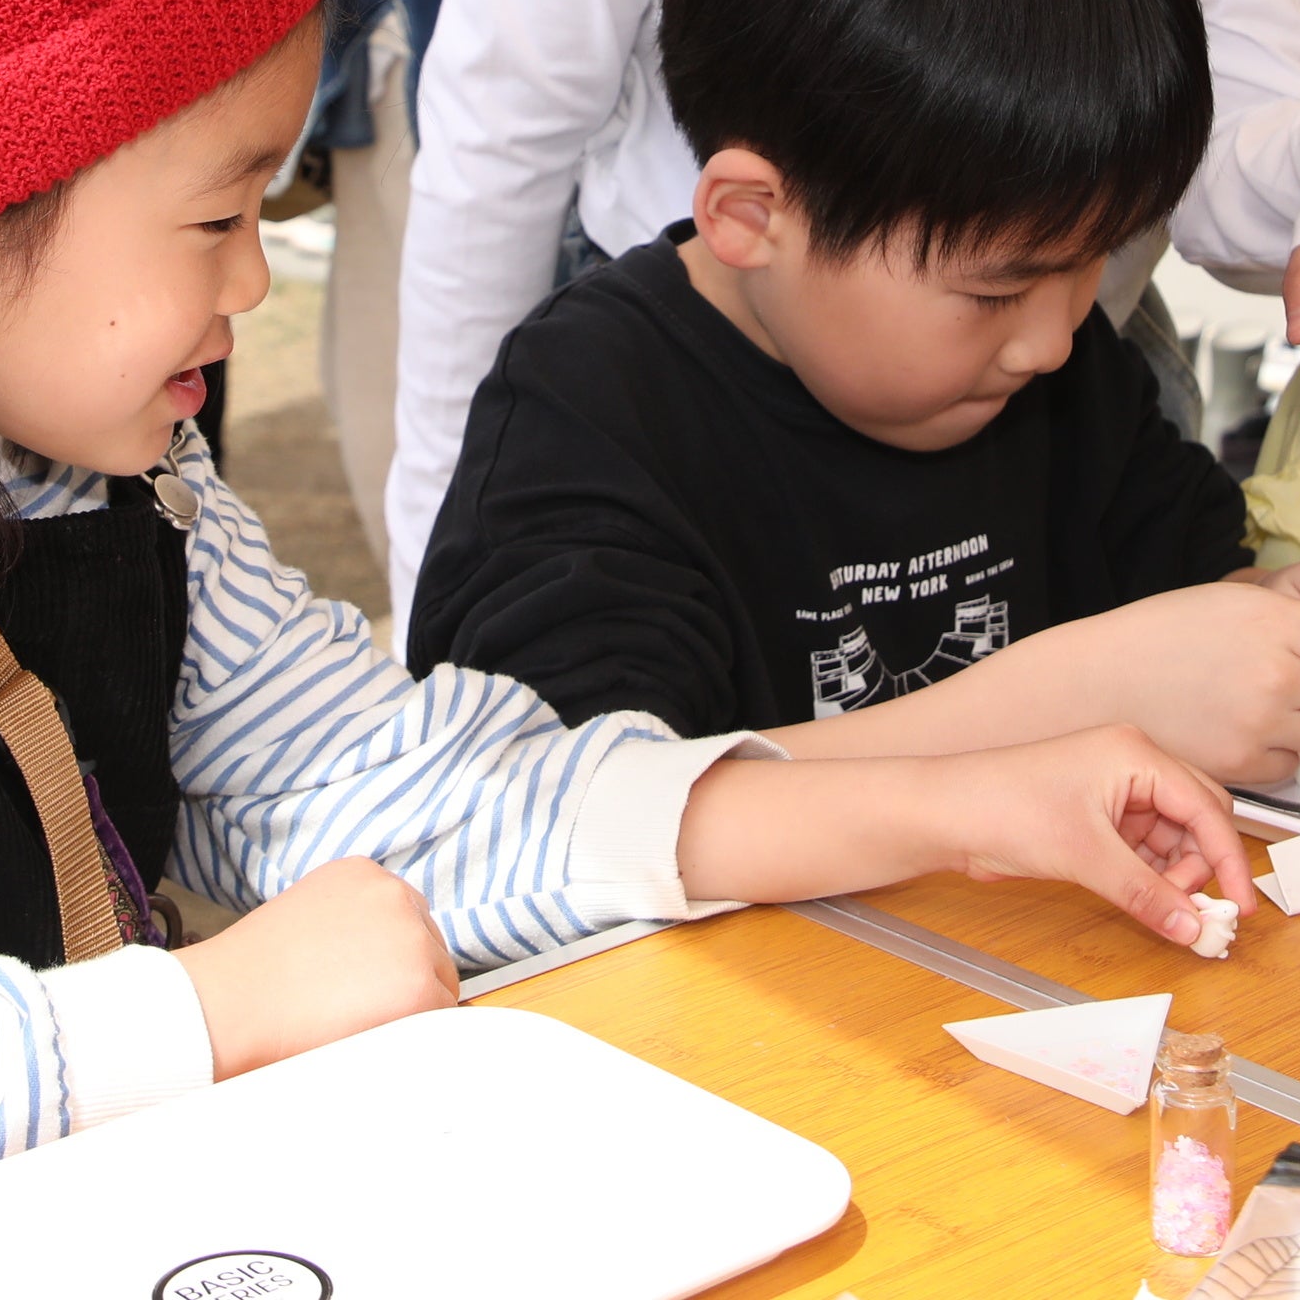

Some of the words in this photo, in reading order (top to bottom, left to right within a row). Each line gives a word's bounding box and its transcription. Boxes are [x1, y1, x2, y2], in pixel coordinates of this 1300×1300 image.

[907, 533, 989, 576] AFTERNOON
[860, 585, 901, 605] NEW
[909, 573, 949, 600] YORK
[174, 1260, 274, 1300] BASIC
